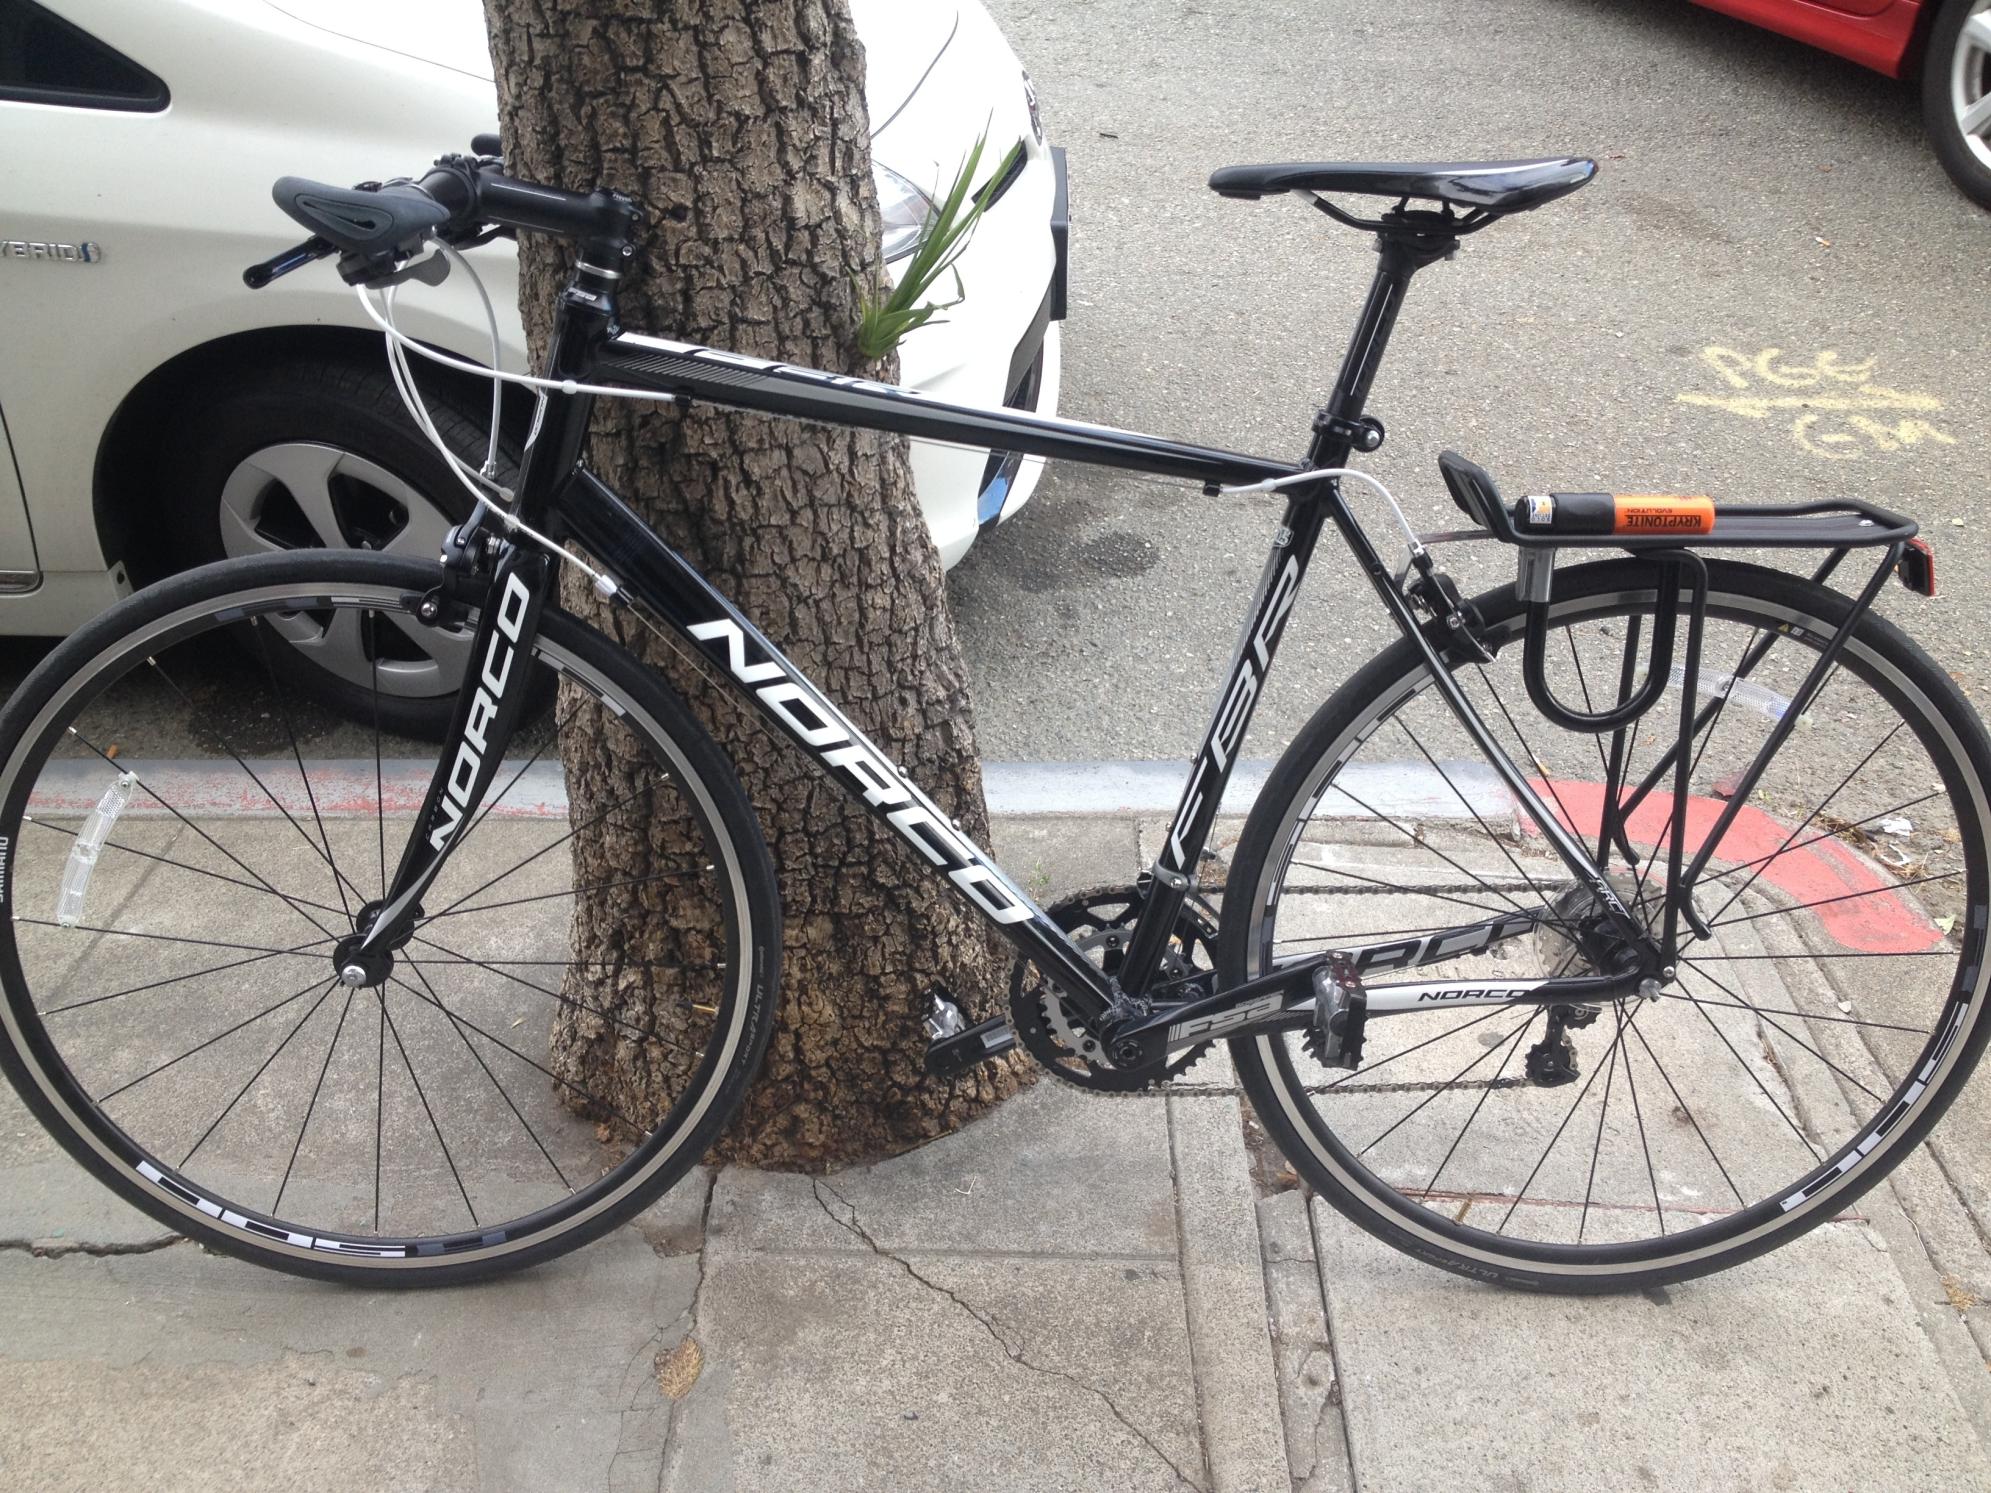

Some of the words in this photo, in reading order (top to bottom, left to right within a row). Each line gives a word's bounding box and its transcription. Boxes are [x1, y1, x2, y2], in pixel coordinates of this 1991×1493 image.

[1625, 514, 1701, 529] KRYPTONITE
[429, 572, 530, 851] NORCO
[686, 618, 1034, 924] NORCO
